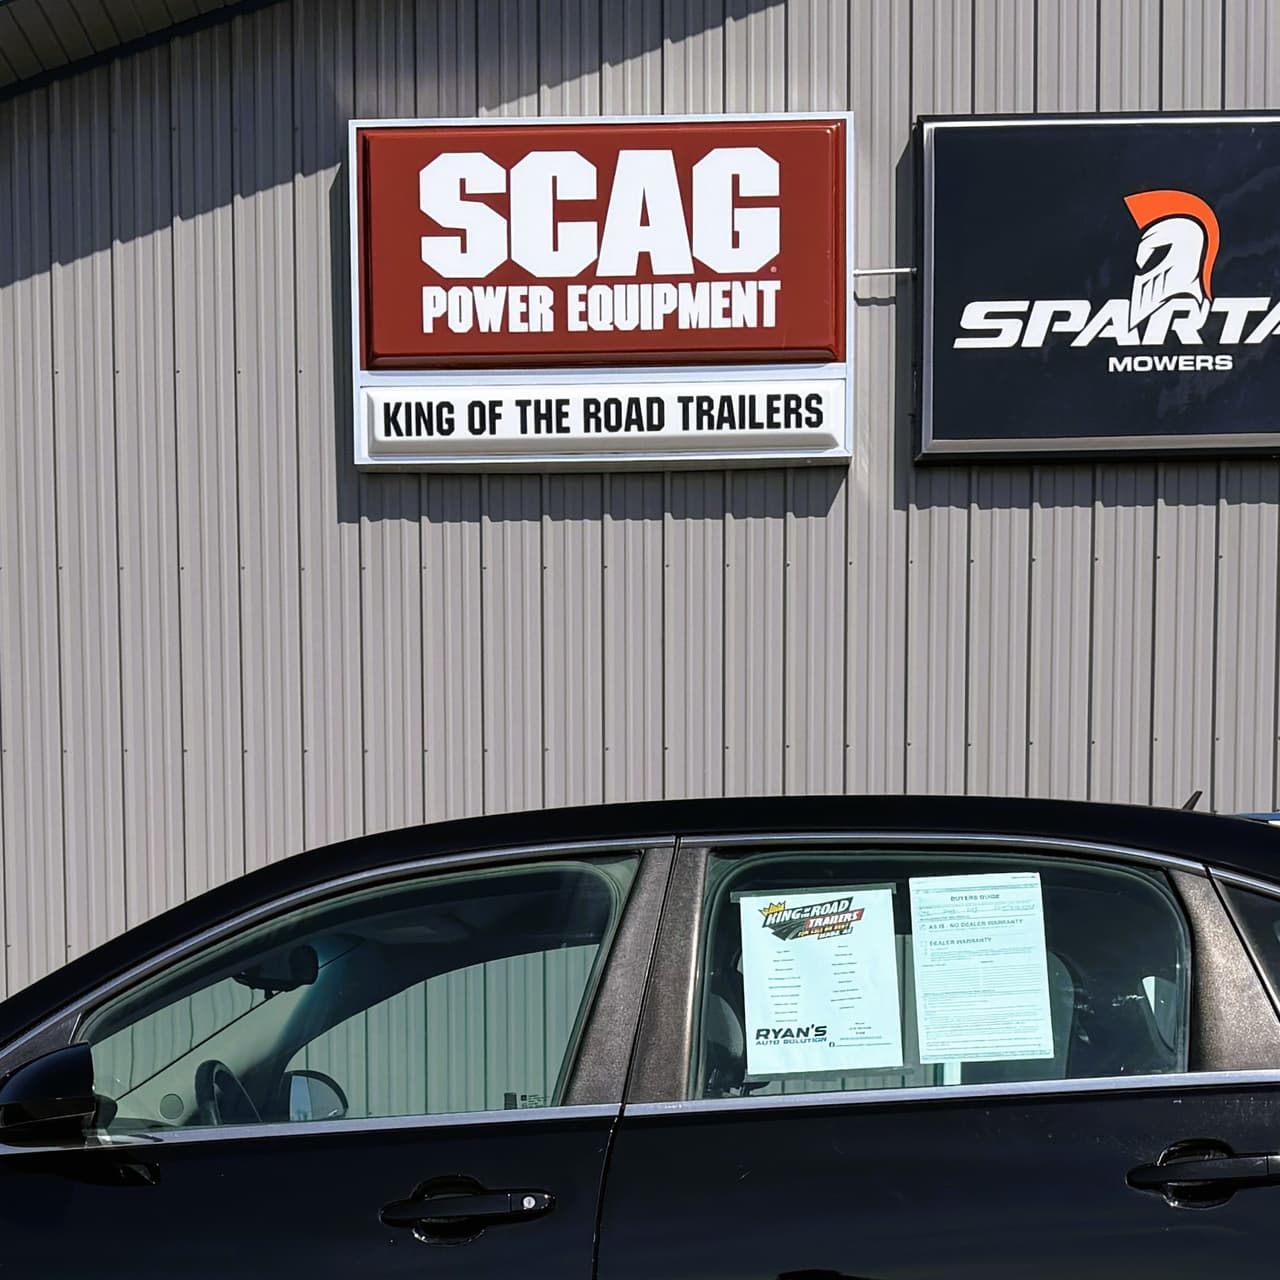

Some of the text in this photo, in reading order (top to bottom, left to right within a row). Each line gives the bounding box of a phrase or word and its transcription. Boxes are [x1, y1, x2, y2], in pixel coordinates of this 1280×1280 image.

[419, 147, 781, 279] SCAG
[422, 280, 782, 334] POWER EQUIPMENT
[1108, 354, 1233, 373] MOWERS
[383, 393, 824, 438] KING OF THE ROAD TRAILERS
[765, 908, 803, 926] KING
[810, 899, 850, 918] ROAD
[755, 1023, 828, 1040] RYAN'S
